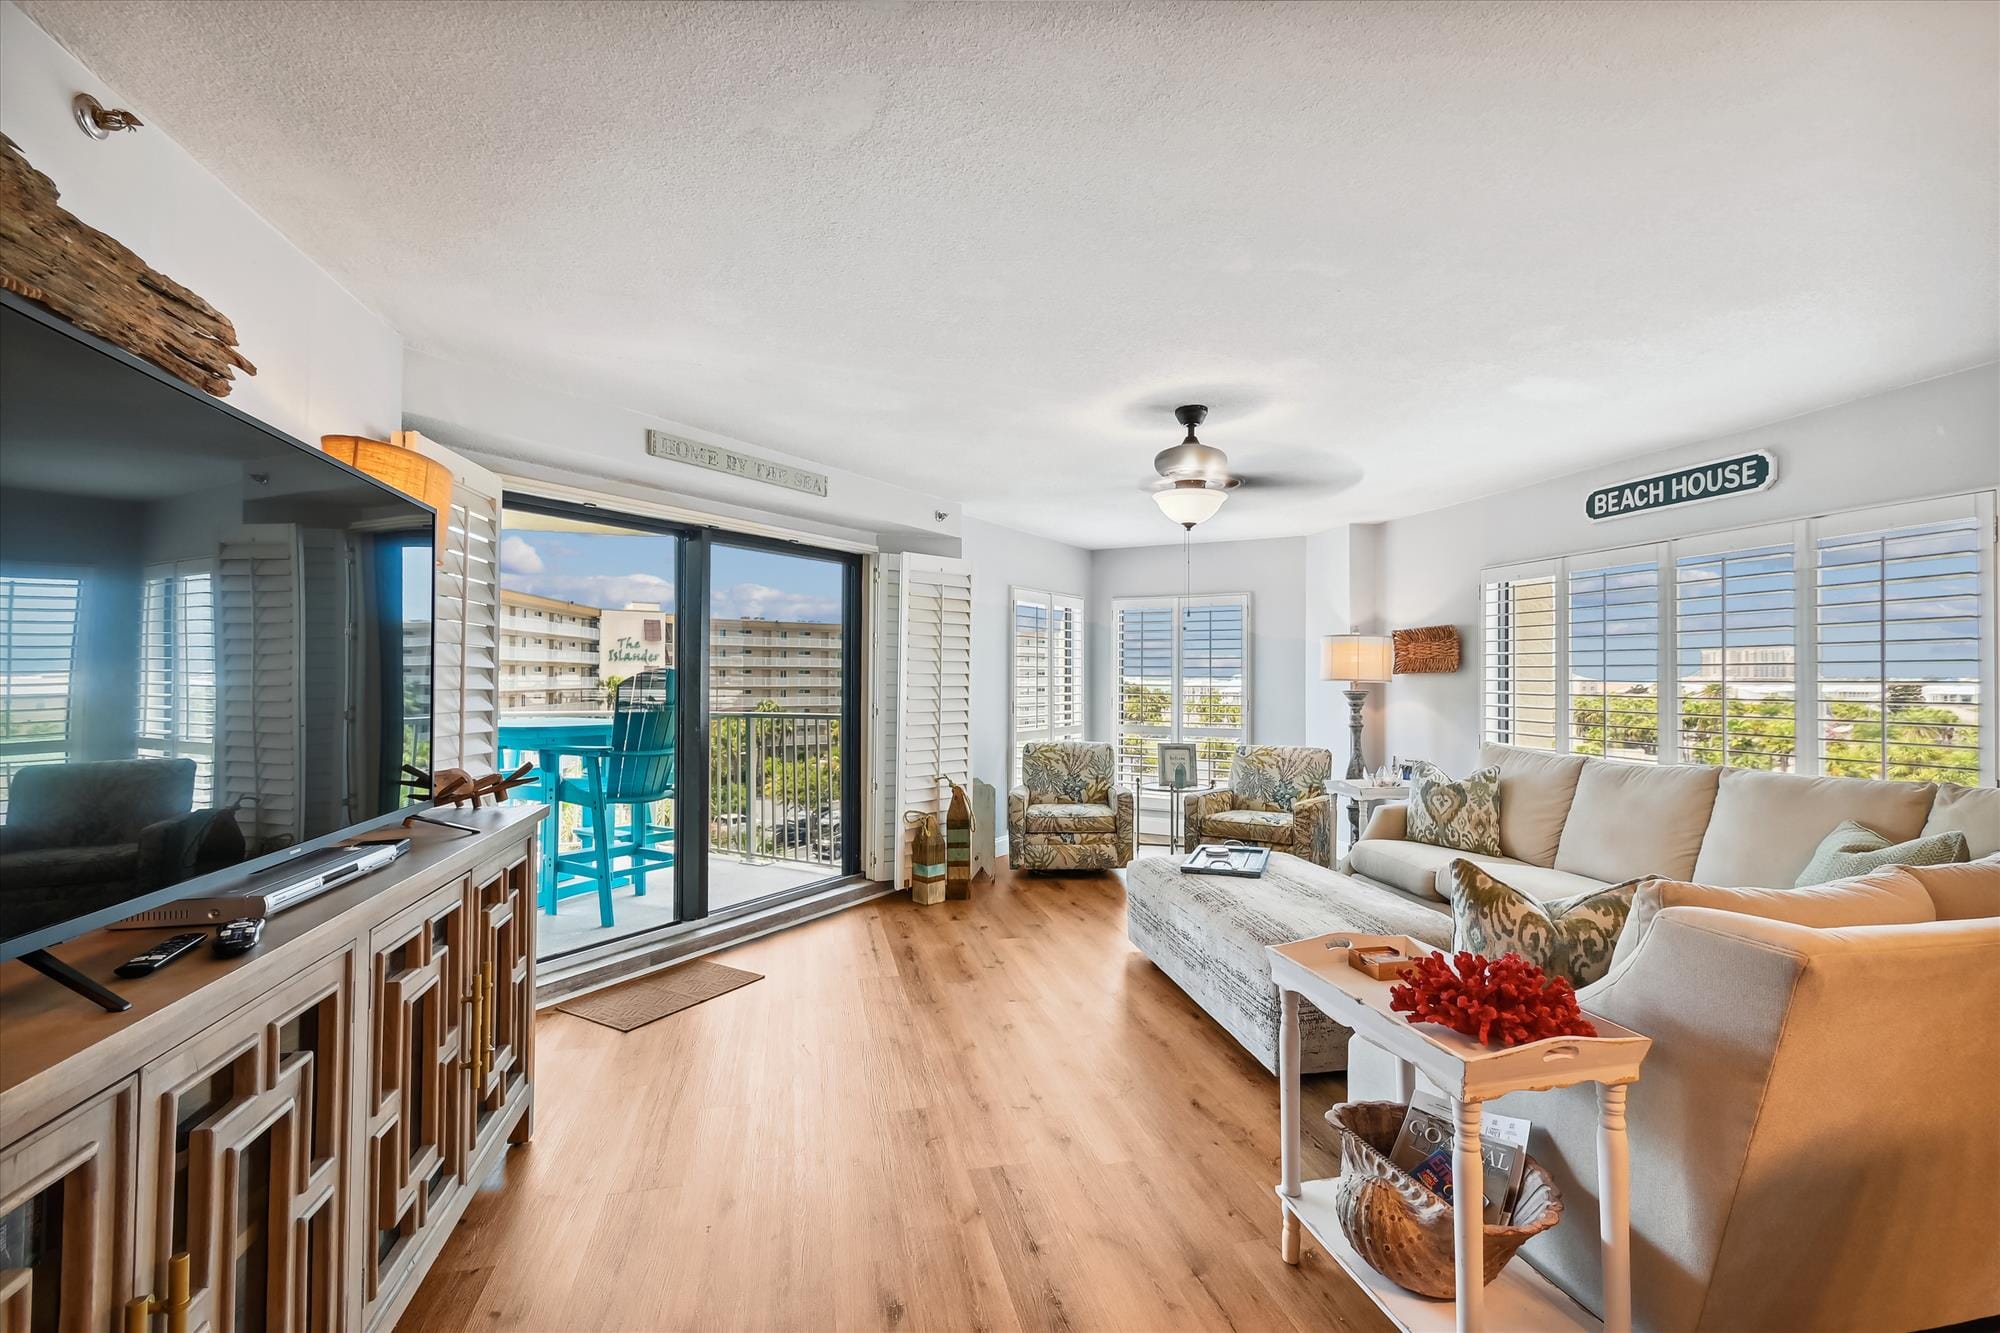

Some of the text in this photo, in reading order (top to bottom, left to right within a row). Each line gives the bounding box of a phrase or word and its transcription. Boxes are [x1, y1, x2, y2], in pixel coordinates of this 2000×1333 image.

[660, 437, 822, 492] HOME BY THE SEA
[1594, 460, 1757, 515] BEACH HOUSE
[608, 648, 660, 665] Islander
[617, 636, 640, 649] The
